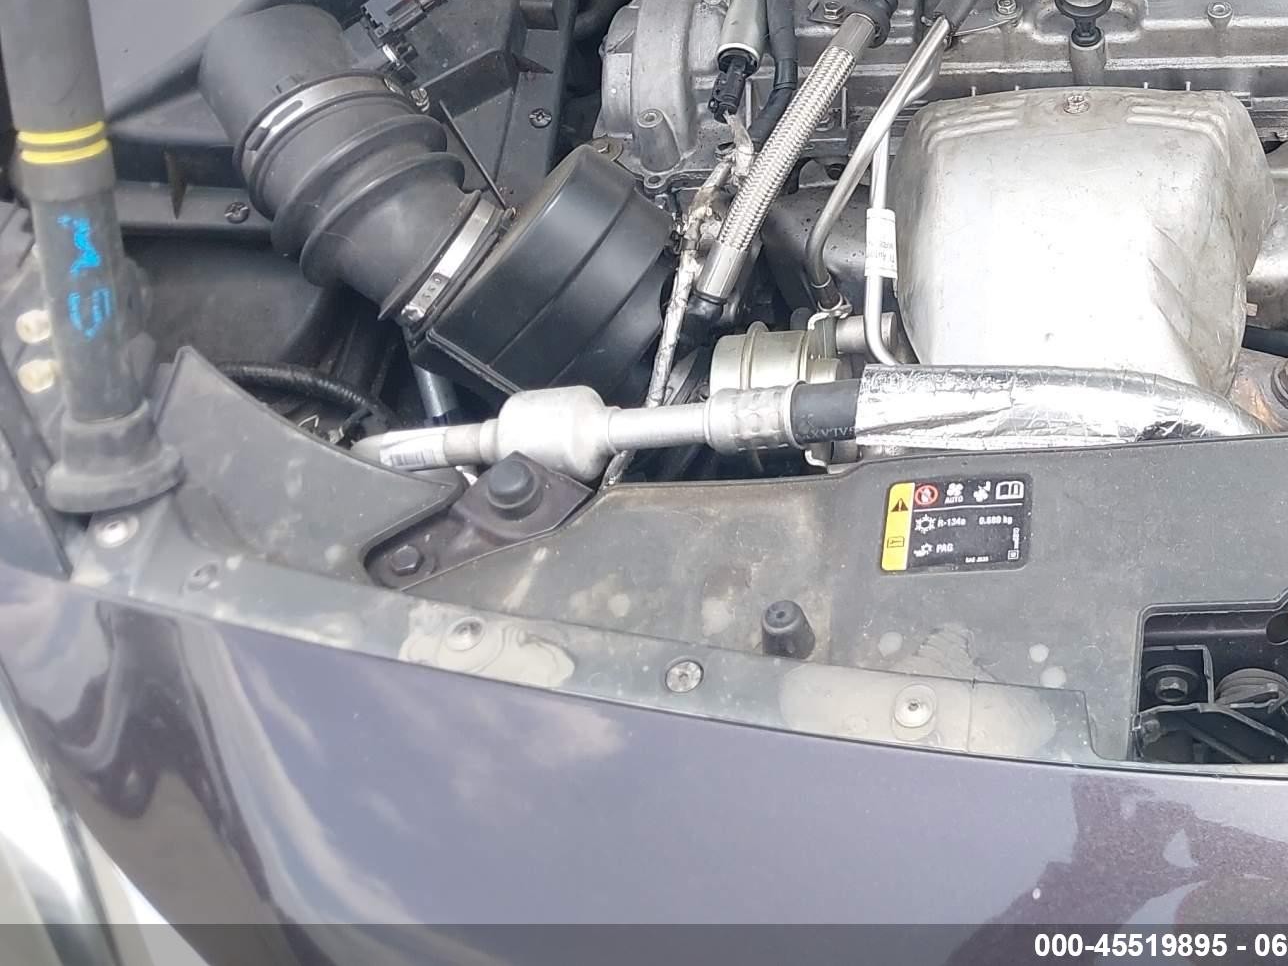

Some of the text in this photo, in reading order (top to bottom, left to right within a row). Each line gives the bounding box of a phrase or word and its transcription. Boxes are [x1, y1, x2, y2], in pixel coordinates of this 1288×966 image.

[944, 496, 964, 504] AUTO
[937, 516, 967, 528] R-134a
[1002, 515, 1013, 525] kg
[935, 543, 954, 553] PAG
